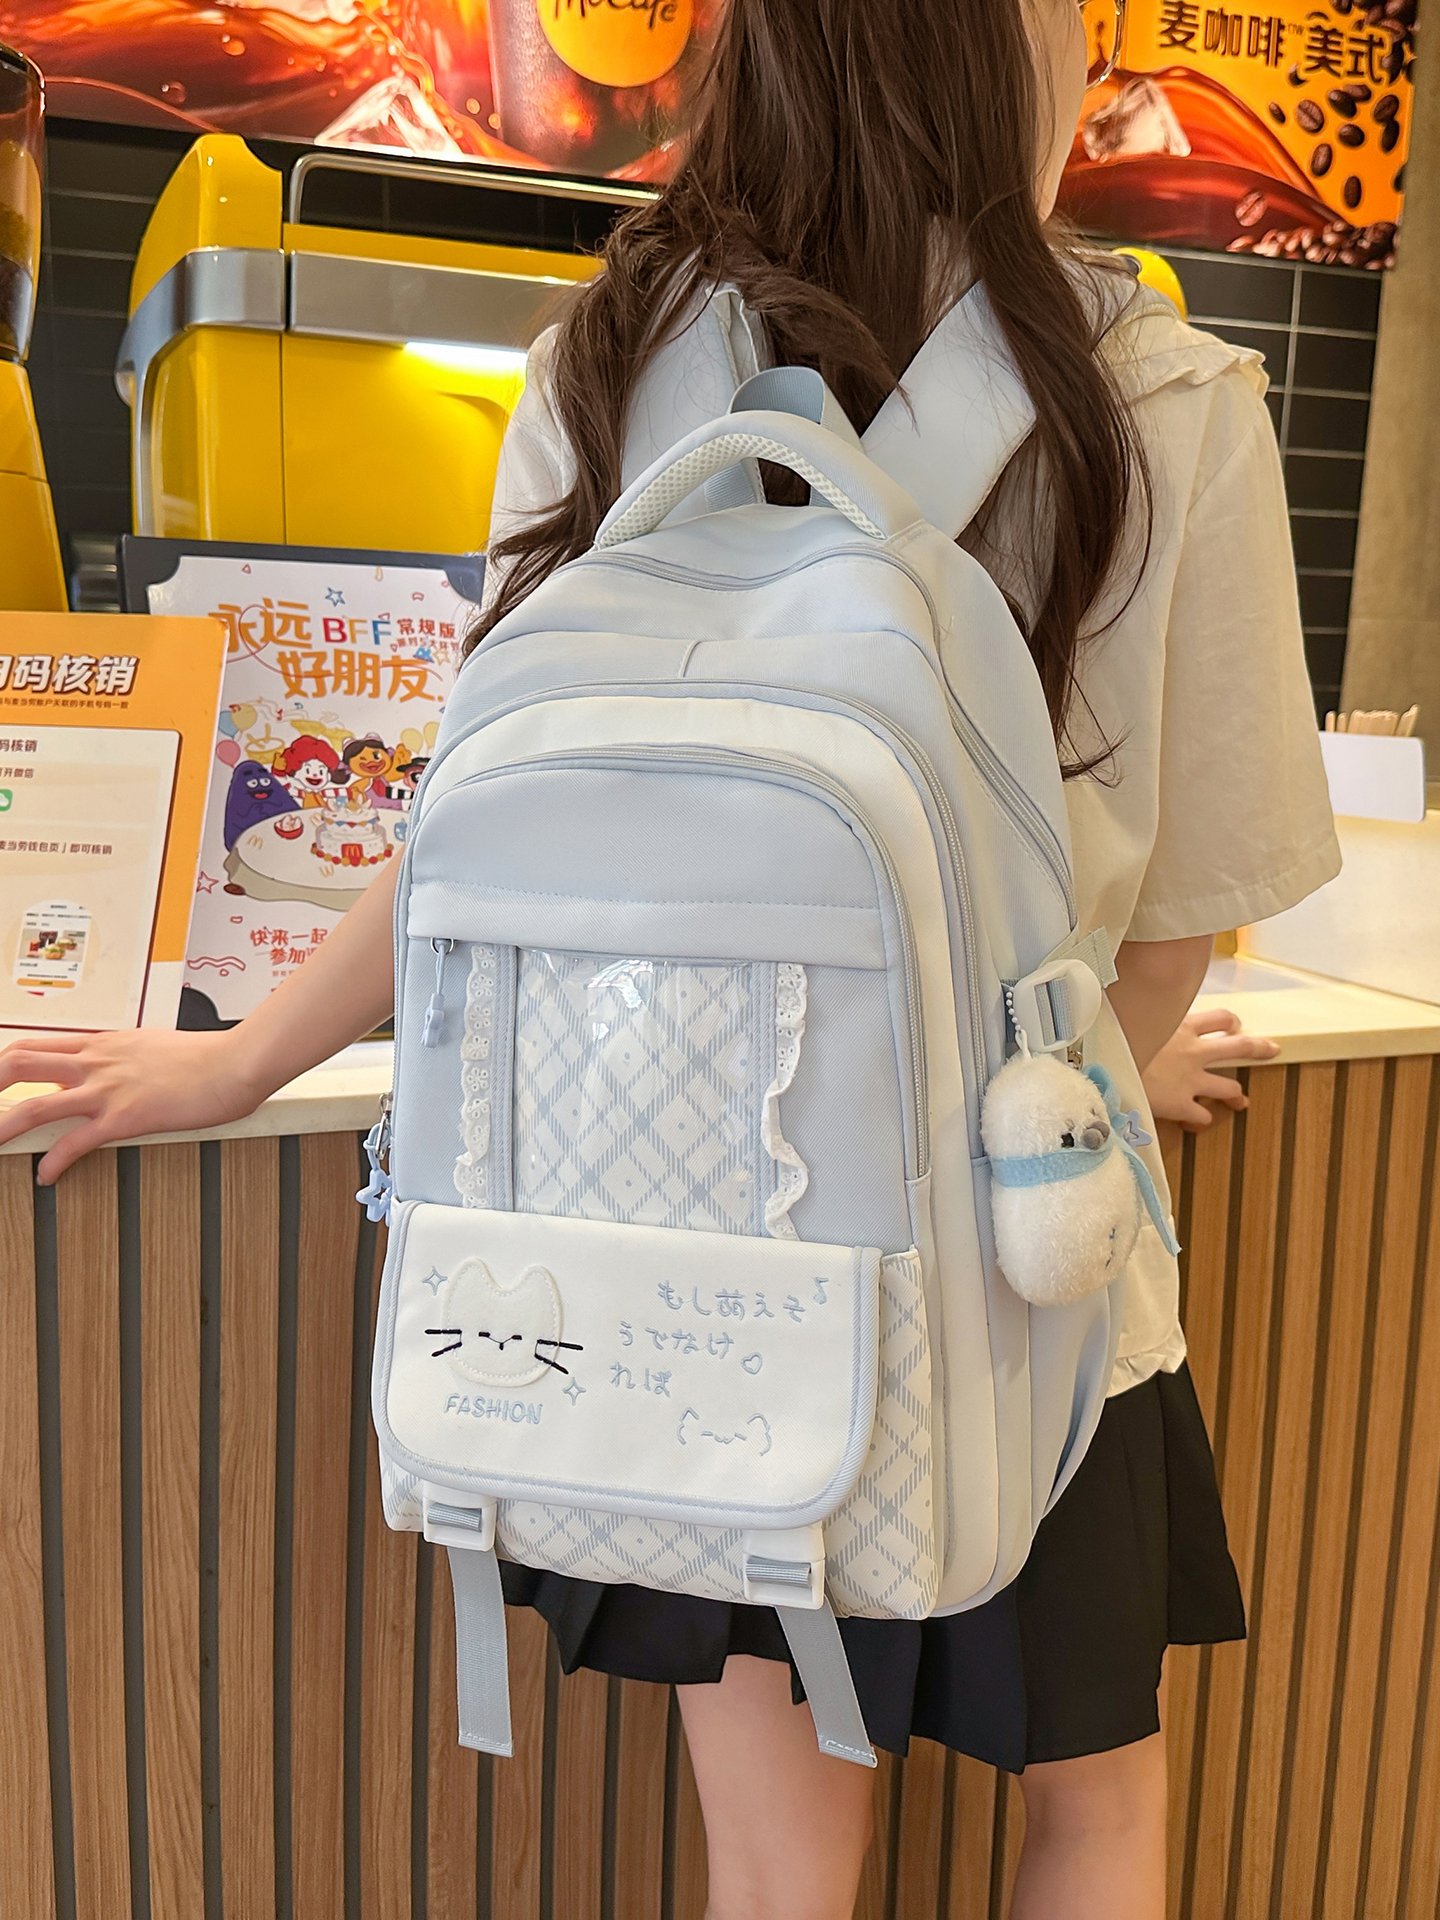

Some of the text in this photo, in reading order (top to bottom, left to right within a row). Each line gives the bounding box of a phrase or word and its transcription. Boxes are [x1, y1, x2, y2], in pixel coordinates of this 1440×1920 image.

[208, 597, 391, 653] 永远 BFF
[397, 618, 456, 639] 常规版
[0, 767, 34, 778] 开微信
[609, 1361, 673, 1399] れば
[443, 1392, 544, 1425] FASHION
